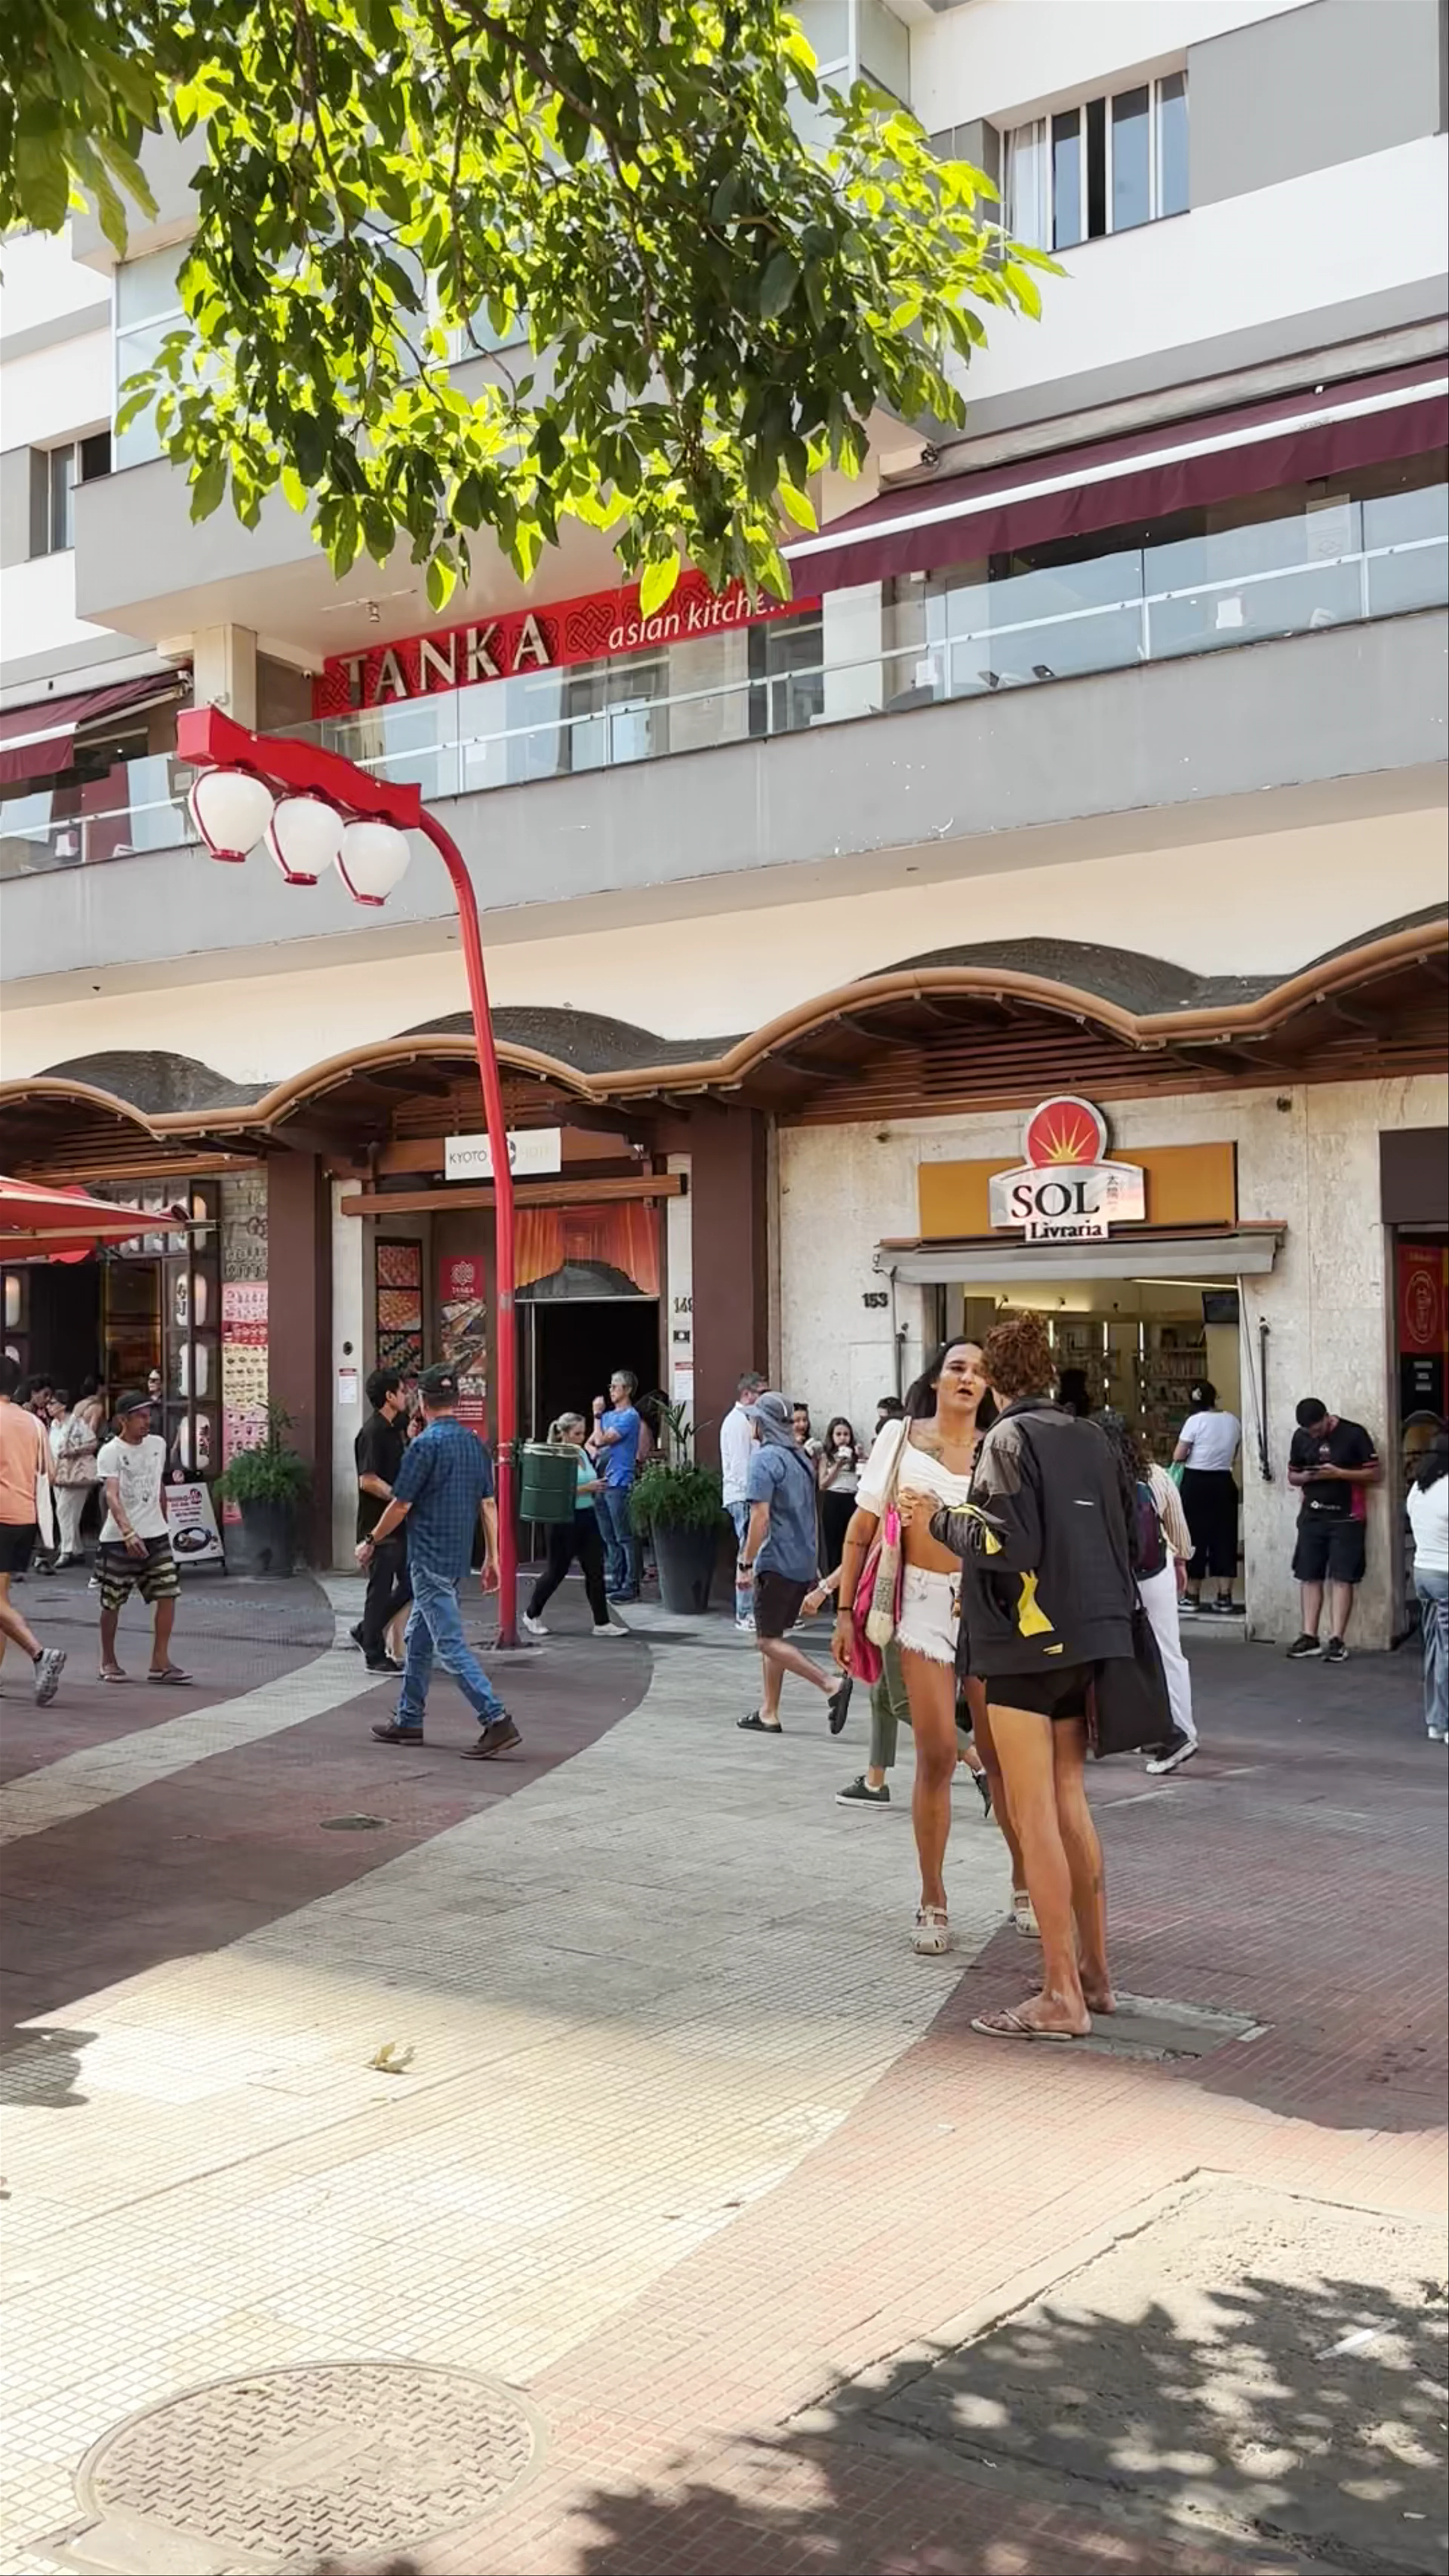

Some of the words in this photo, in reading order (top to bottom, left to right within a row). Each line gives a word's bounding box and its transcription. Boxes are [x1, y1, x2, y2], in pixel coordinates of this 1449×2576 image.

[608, 612, 679, 649] asian
[688, 589, 785, 632] kitche
[340, 613, 550, 708] TANKA
[449, 1150, 487, 1164] KYOTO
[1011, 1181, 1100, 1218] SOL
[1031, 1219, 1103, 1239] Livraria
[861, 1292, 888, 1309] 153
